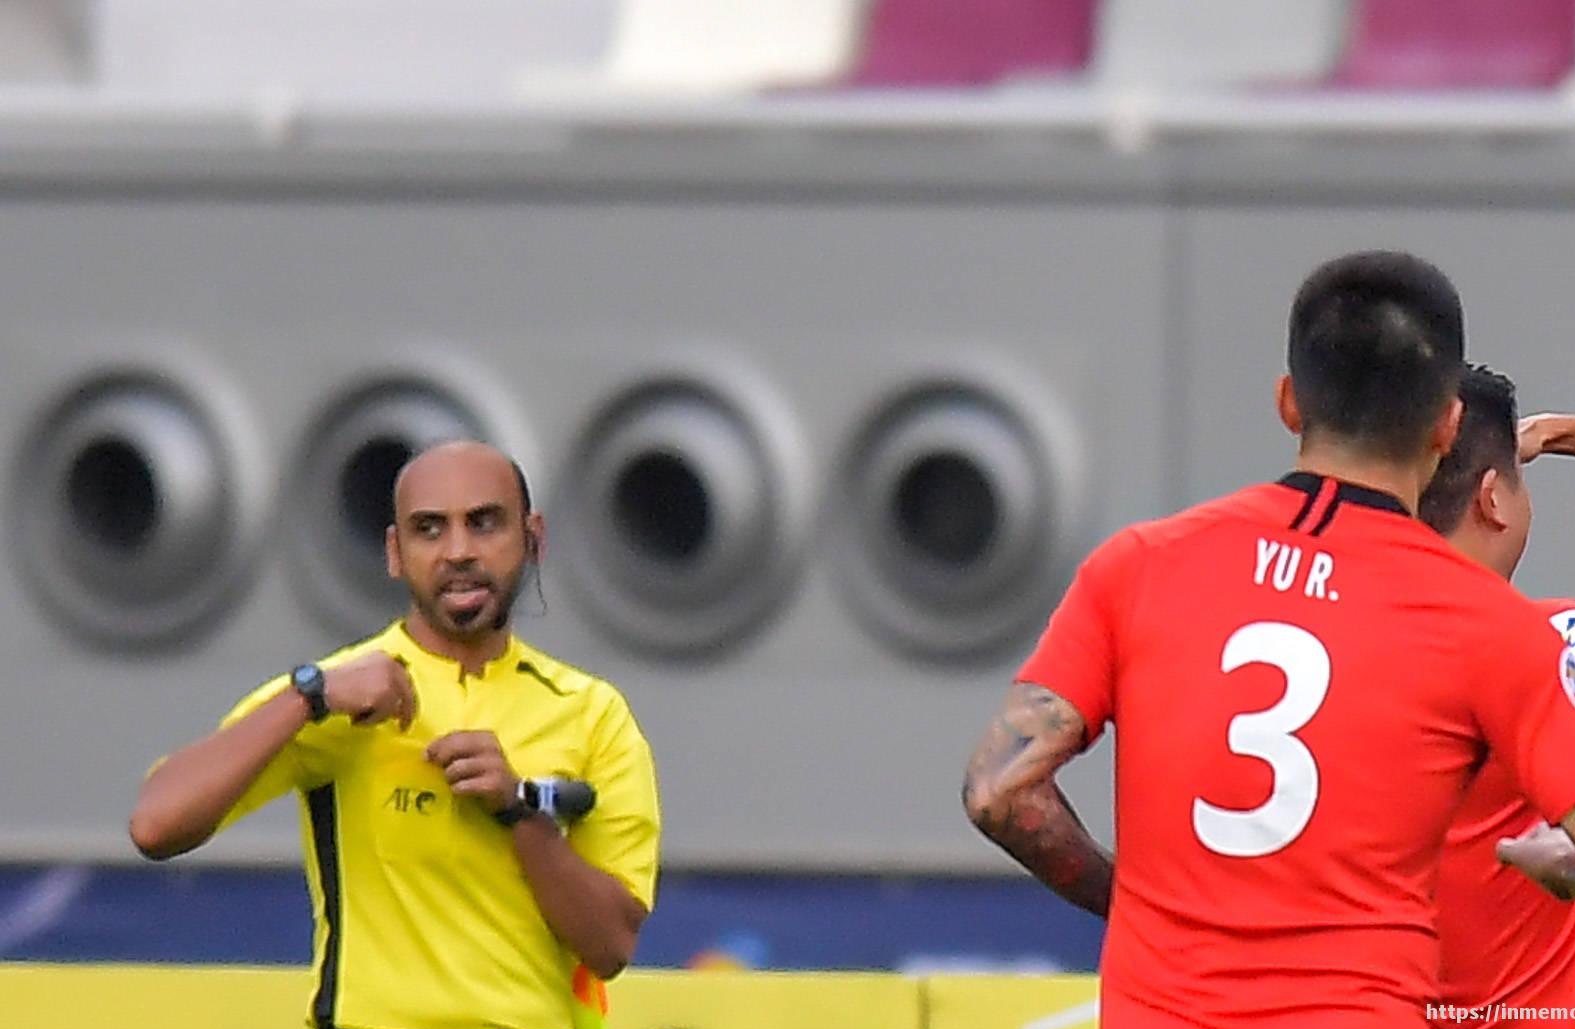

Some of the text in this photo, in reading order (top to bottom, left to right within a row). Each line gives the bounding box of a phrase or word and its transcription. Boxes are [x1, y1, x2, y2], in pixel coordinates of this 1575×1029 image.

[1254, 537, 1340, 601] YU R.
[1193, 621, 1331, 857] 3
